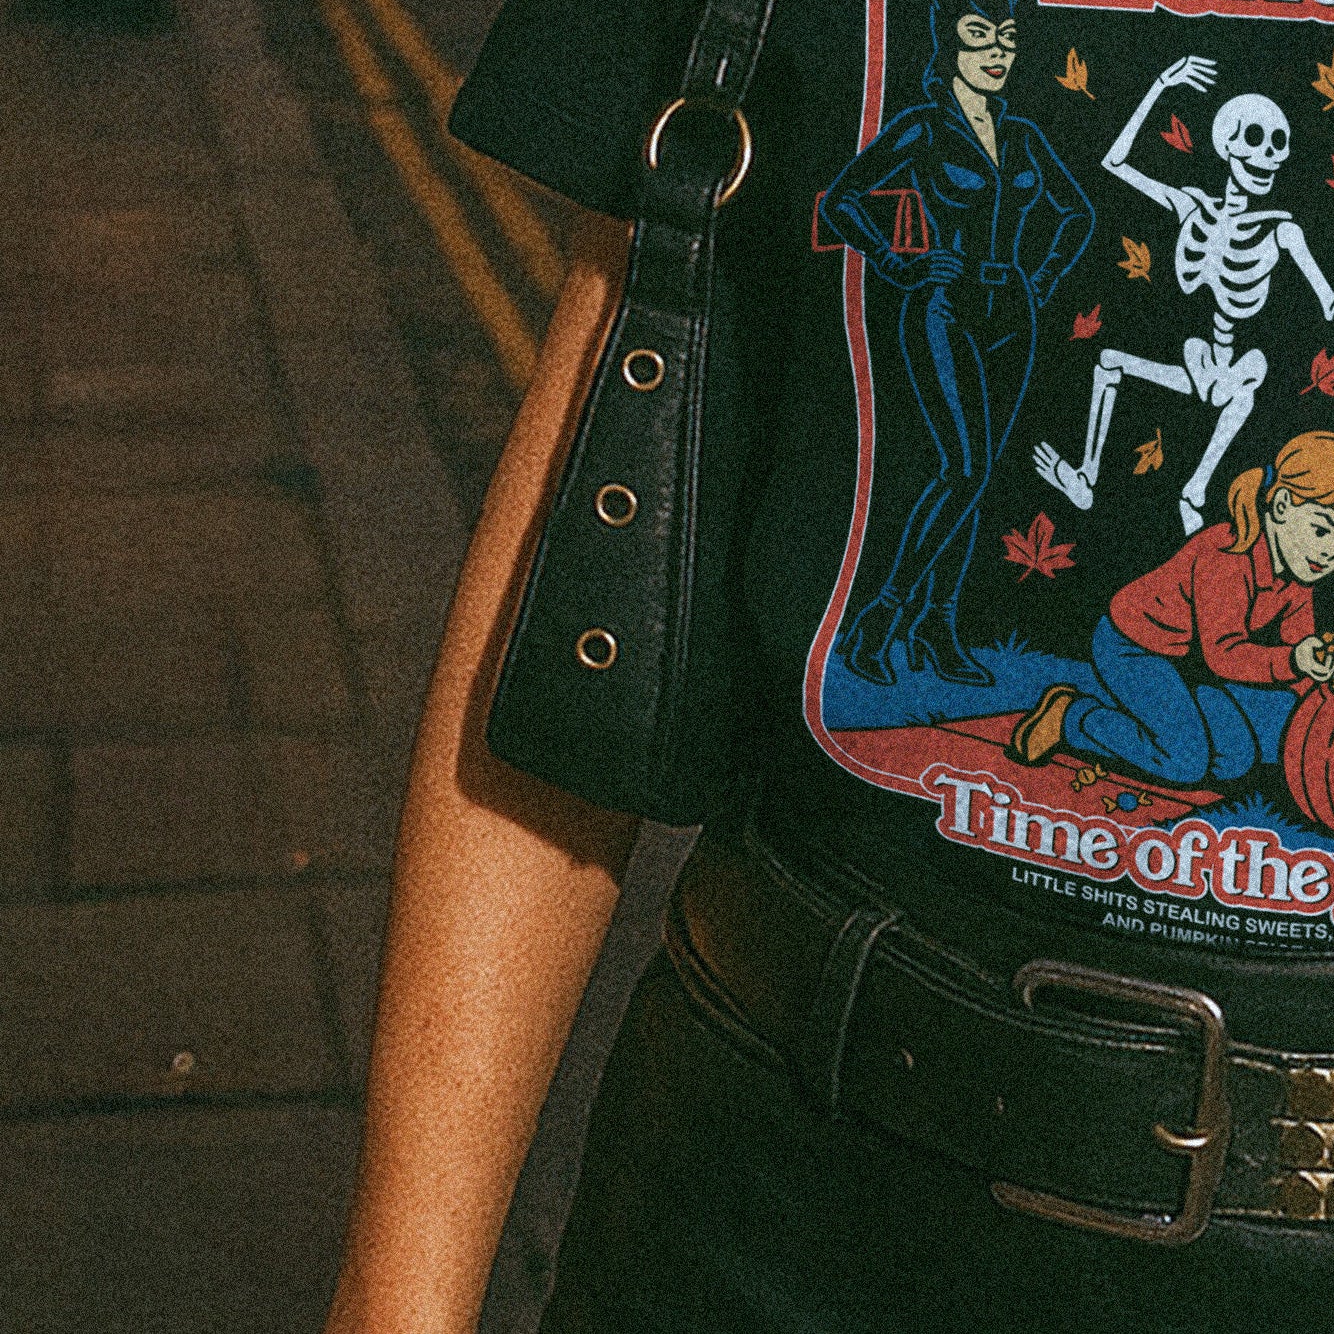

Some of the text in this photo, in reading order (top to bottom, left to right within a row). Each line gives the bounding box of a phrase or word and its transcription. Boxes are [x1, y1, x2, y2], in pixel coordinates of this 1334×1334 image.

[933, 773, 1121, 871] Time
[1134, 830, 1210, 888] of
[1218, 838, 1331, 904] the
[1011, 867, 1077, 898] LITTLE
[1081, 884, 1139, 912] SHITS
[1142, 898, 1241, 932] STEALING
[1245, 917, 1334, 943] SWEETS,
[1101, 912, 1146, 933] AND
